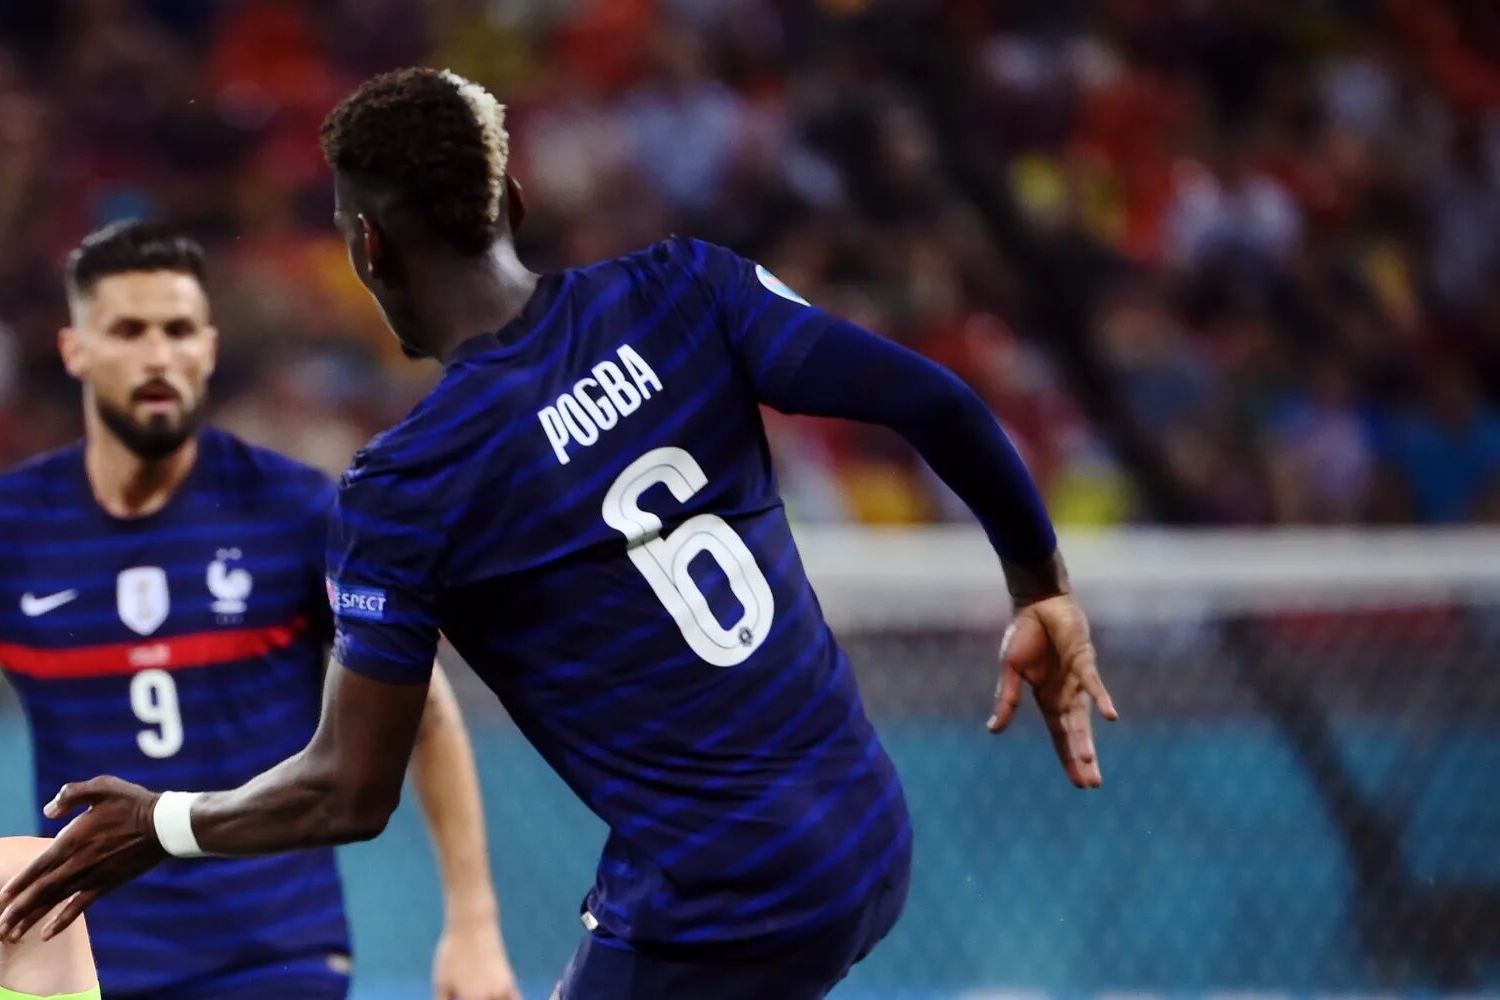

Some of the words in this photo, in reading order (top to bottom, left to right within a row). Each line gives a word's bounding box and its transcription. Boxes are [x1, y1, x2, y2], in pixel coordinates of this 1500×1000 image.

[537, 343, 664, 465] POGBA
[601, 446, 775, 668] 6
[129, 668, 184, 759] 9
